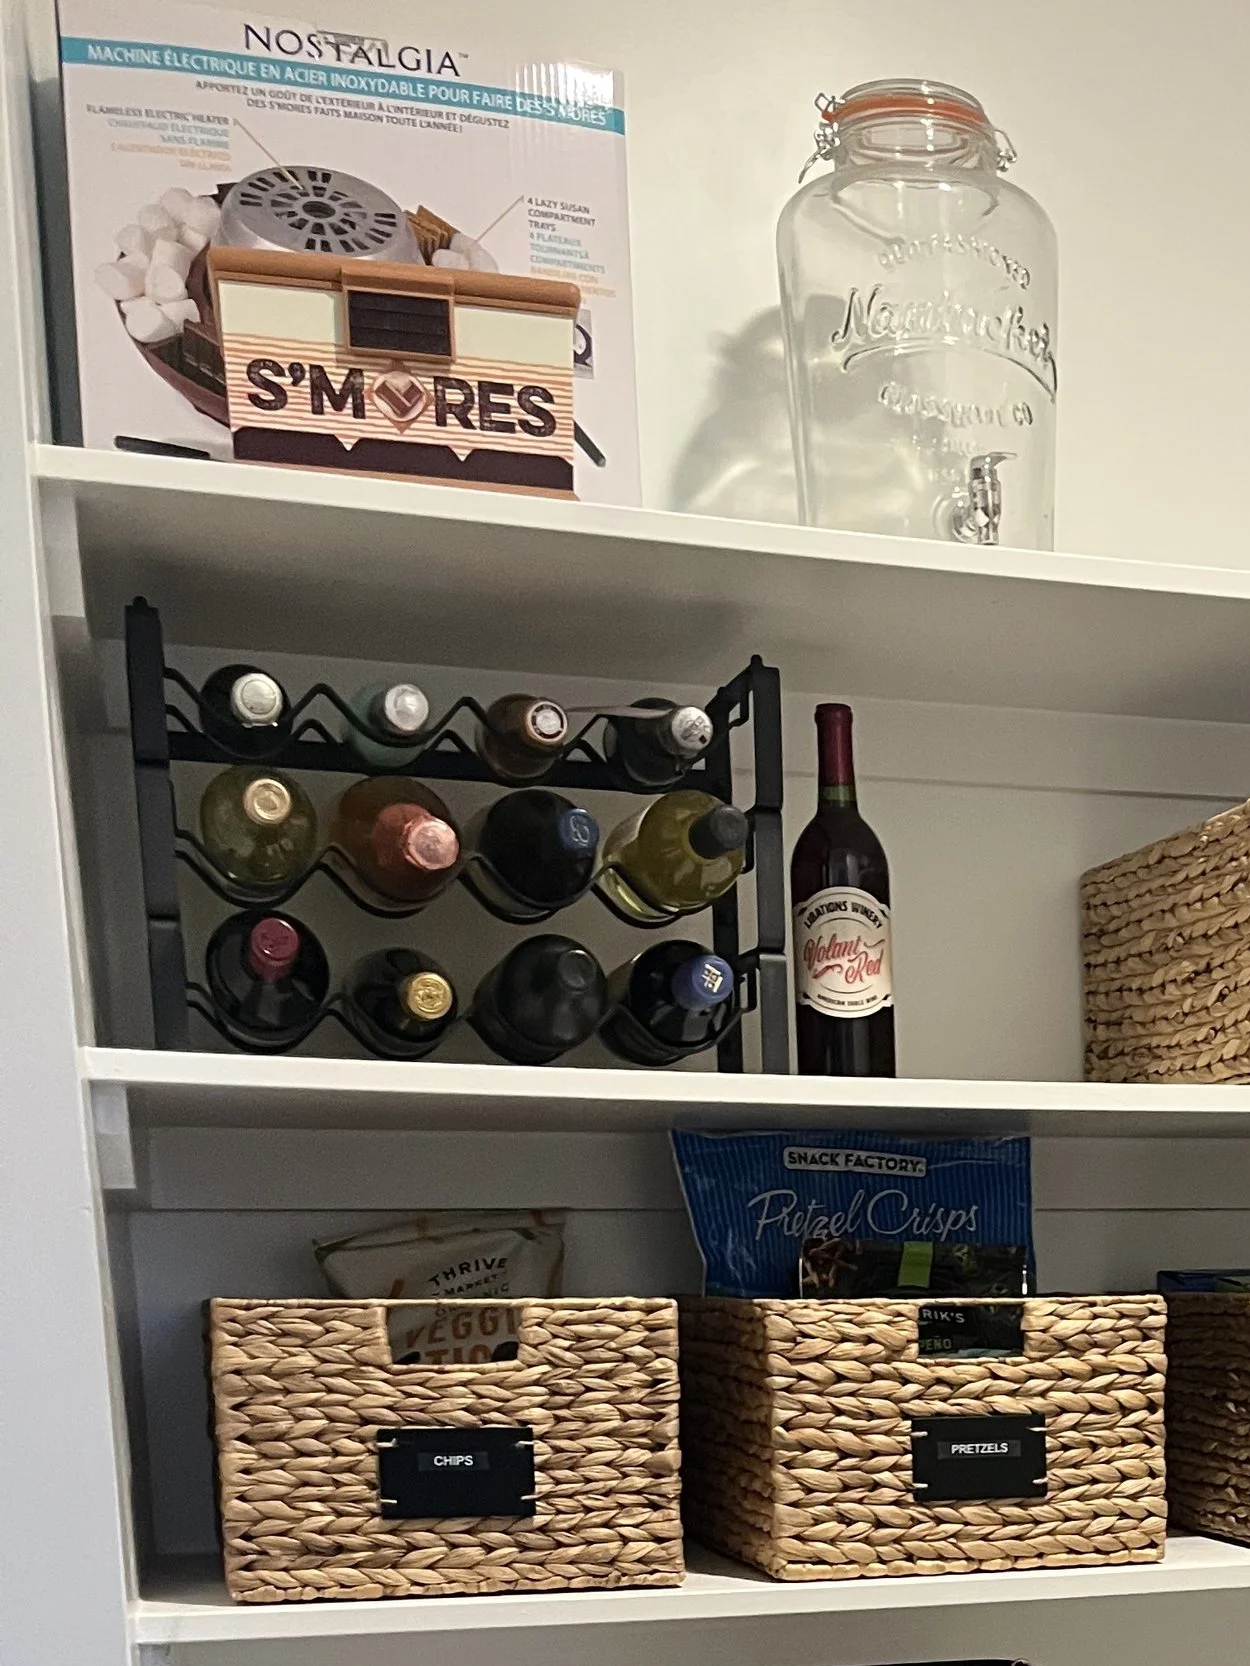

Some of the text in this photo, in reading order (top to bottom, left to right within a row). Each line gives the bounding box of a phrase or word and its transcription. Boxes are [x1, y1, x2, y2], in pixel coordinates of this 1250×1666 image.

[87, 44, 161, 65] MACHINE
[163, 48, 256, 78] ÉLECTRIQUE
[260, 63, 281, 80] EN
[284, 67, 329, 86] ACIER
[330, 72, 426, 98] INOXYDABLE
[428, 85, 470, 104] POUR
[472, 91, 513, 110] FAIRE
[251, 87, 266, 98] UN
[535, 197, 558, 210] LAZY
[845, 950, 885, 984] Red
[787, 1151, 841, 1167] SNACK
[747, 1188, 979, 1242] Pretzel Crisps
[427, 1256, 509, 1288] THRIVE
[920, 1308, 966, 1324] RIK'S
[404, 1305, 518, 1348] VEGGI
[951, 1442, 1009, 1455] PRETZELS
[432, 1455, 474, 1467] CHIPS
